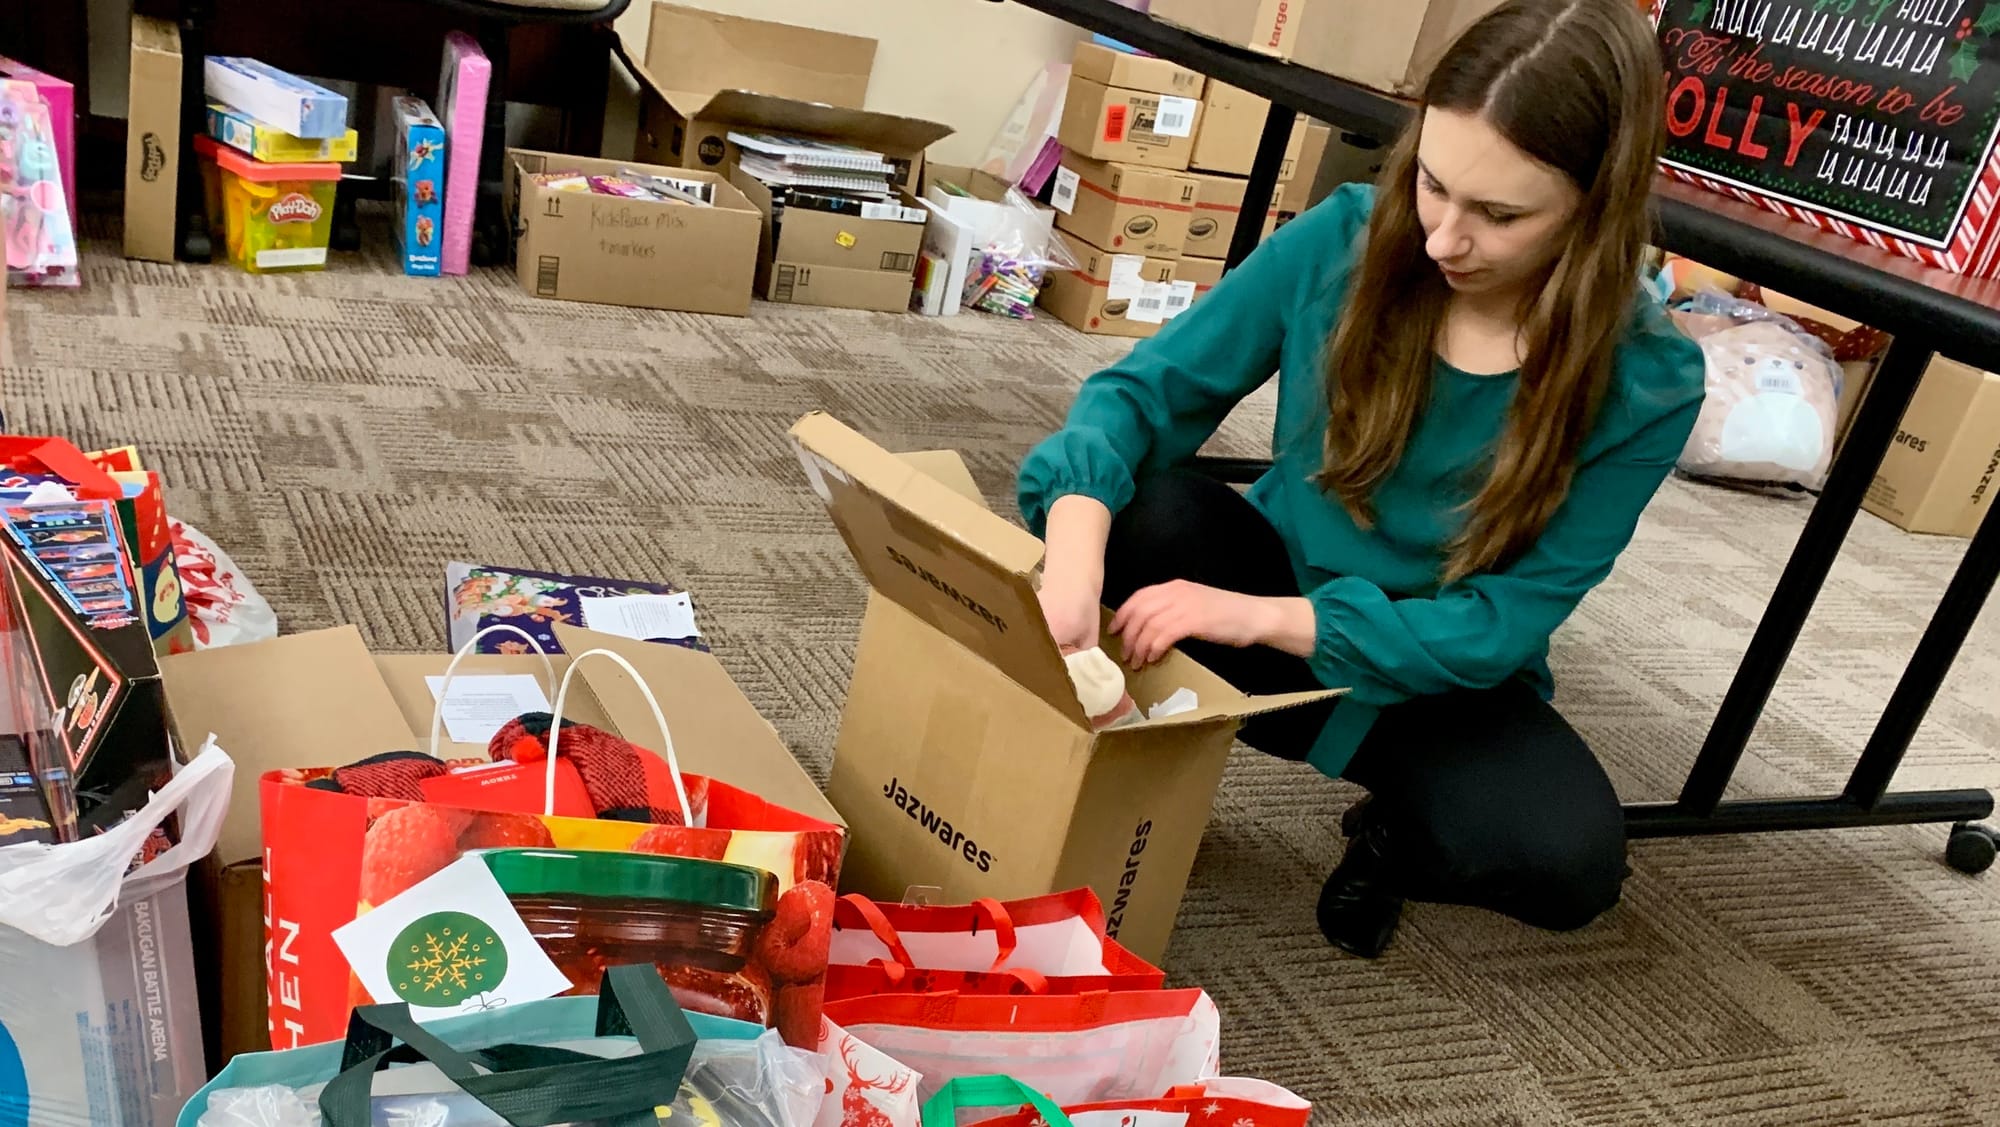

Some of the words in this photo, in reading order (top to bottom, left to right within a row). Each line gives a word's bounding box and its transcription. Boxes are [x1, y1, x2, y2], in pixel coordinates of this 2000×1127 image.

[1268, 0, 1288, 47] targe
[1727, 0, 1748, 35] LA
[1771, 5, 1802, 46] LA
[1797, 11, 1829, 51] LA
[1823, 16, 1856, 62] LA,
[1854, 22, 1888, 64] LA
[1881, 28, 1917, 69] LA
[1910, 33, 1945, 75] LA
[1727, 43, 1775, 82] the
[1773, 65, 1878, 106] season
[1876, 85, 1917, 114] to
[1919, 84, 1965, 127] be
[1666, 71, 1827, 167] OLLY
[1831, 114, 1852, 145] FA
[1852, 119, 1874, 150] LA
[1875, 124, 1897, 160] LA,
[1901, 130, 1925, 163] LA
[1924, 136, 1949, 170] LA
[1817, 149, 1839, 184] LA,
[1841, 155, 1864, 187] LA
[1862, 161, 1887, 193] LA
[1885, 167, 1910, 200] LA
[1908, 173, 1933, 206] LA
[1895, 430, 1928, 453] ares
[1971, 442, 2000, 505] Jazwa
[886, 545, 1009, 634] Jazwares
[883, 777, 993, 873] Jazwares
[1106, 819, 1153, 940] azwares
[134, 901, 156, 970] BAKUGAN
[143, 970, 162, 1017] BATTLE
[149, 1017, 168, 1063] ARENA
